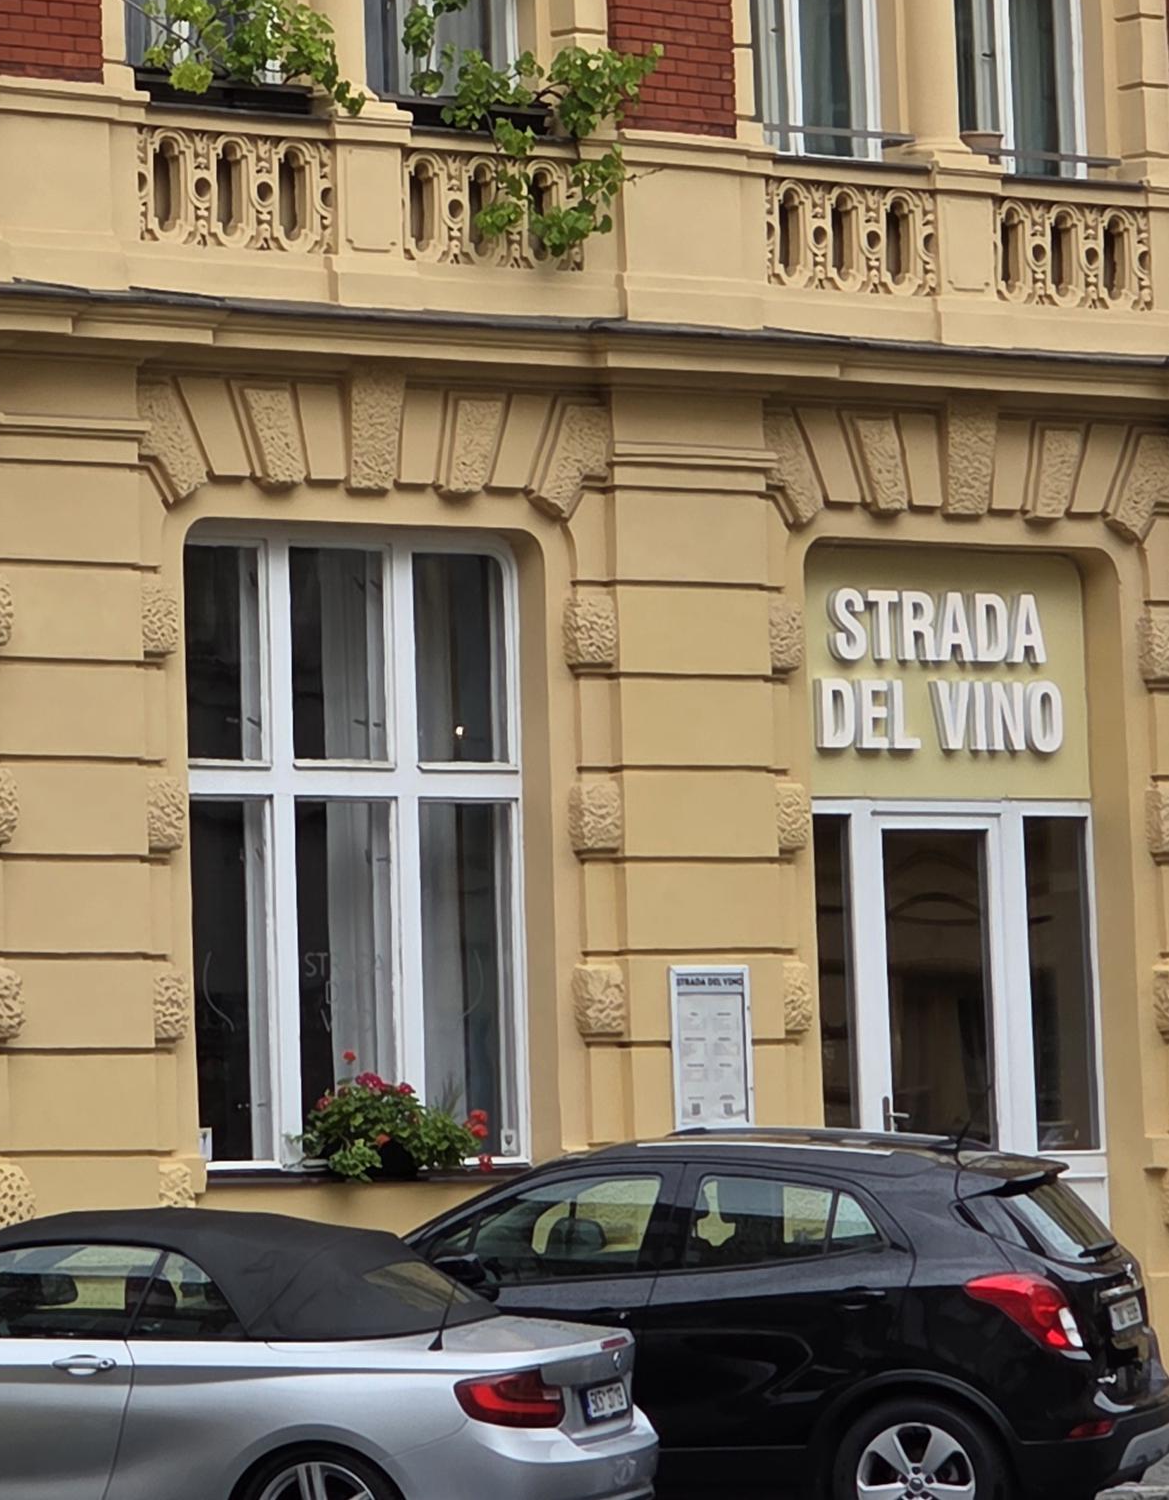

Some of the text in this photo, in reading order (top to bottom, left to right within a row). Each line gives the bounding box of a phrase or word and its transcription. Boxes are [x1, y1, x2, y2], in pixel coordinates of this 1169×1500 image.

[829, 587, 1048, 665] STRADA
[814, 678, 1065, 753] DEL VINO
